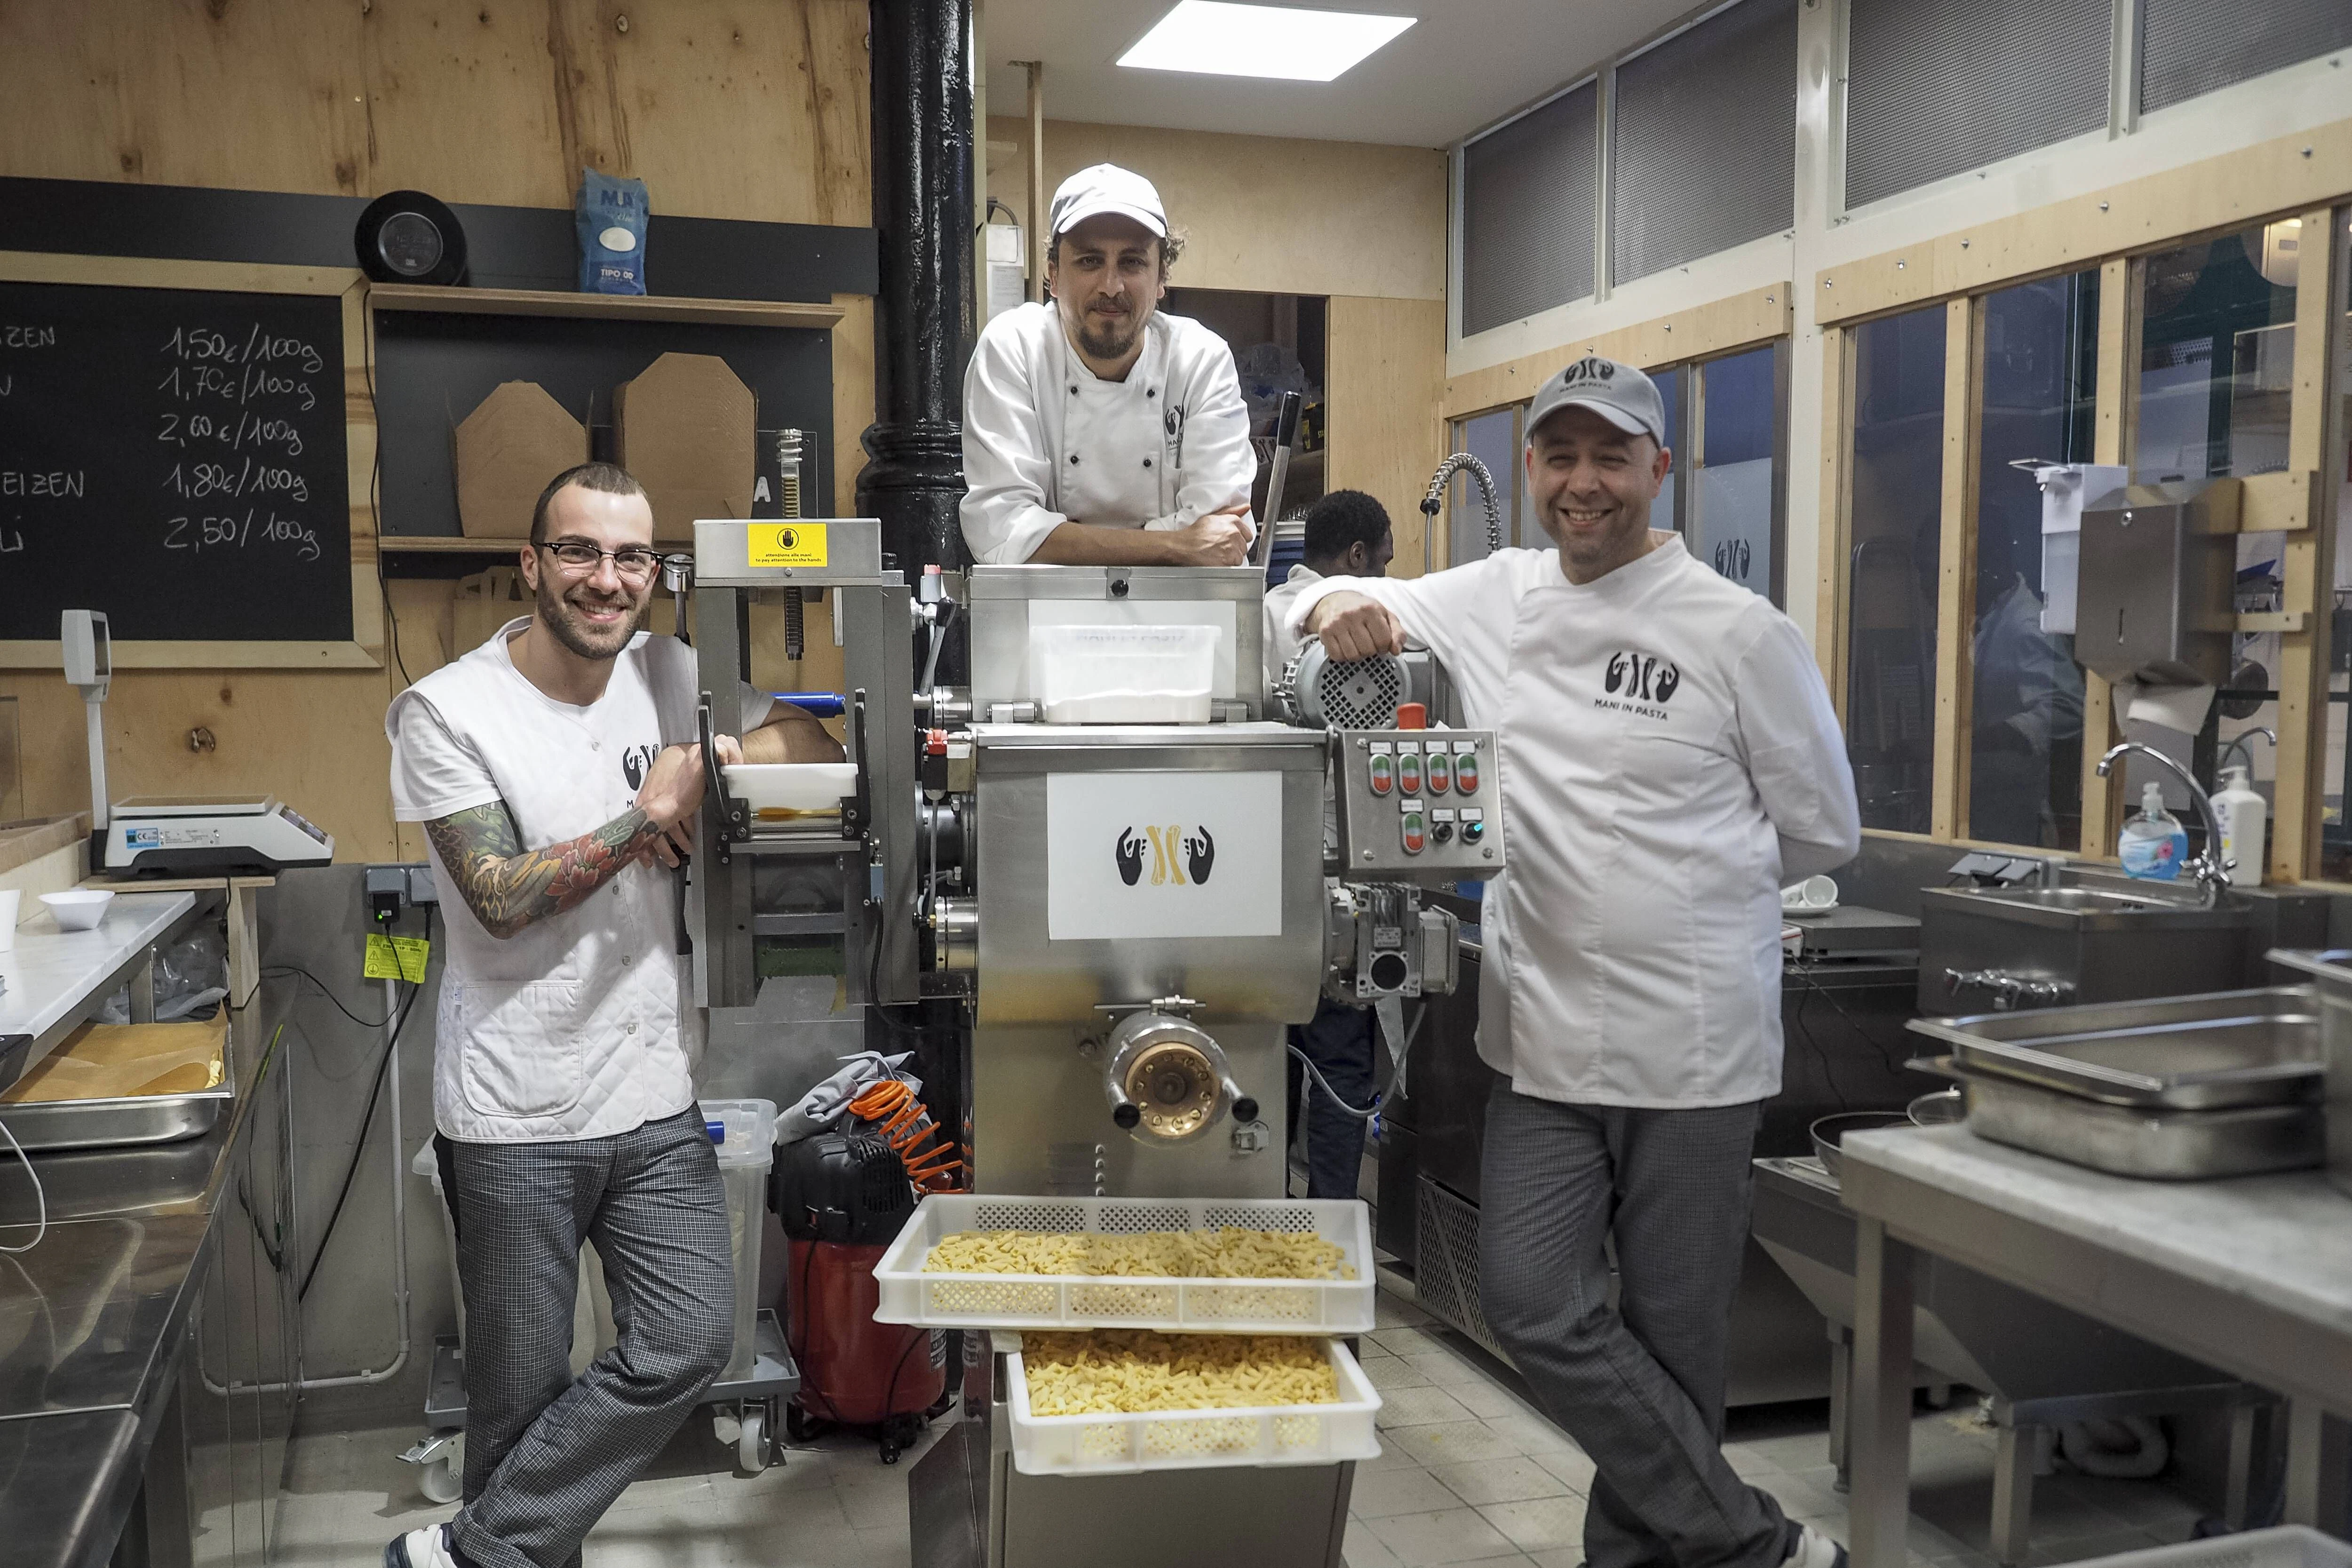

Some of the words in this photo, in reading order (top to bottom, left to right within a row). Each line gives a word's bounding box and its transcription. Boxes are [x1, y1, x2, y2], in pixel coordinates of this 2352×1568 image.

[600, 269, 620, 278] TIPO
[0, 326, 55, 348] ZEN
[1594, 698, 1620, 710] MANI
[1621, 703, 1634, 713] IN
[1635, 706, 1668, 722] PASTA
